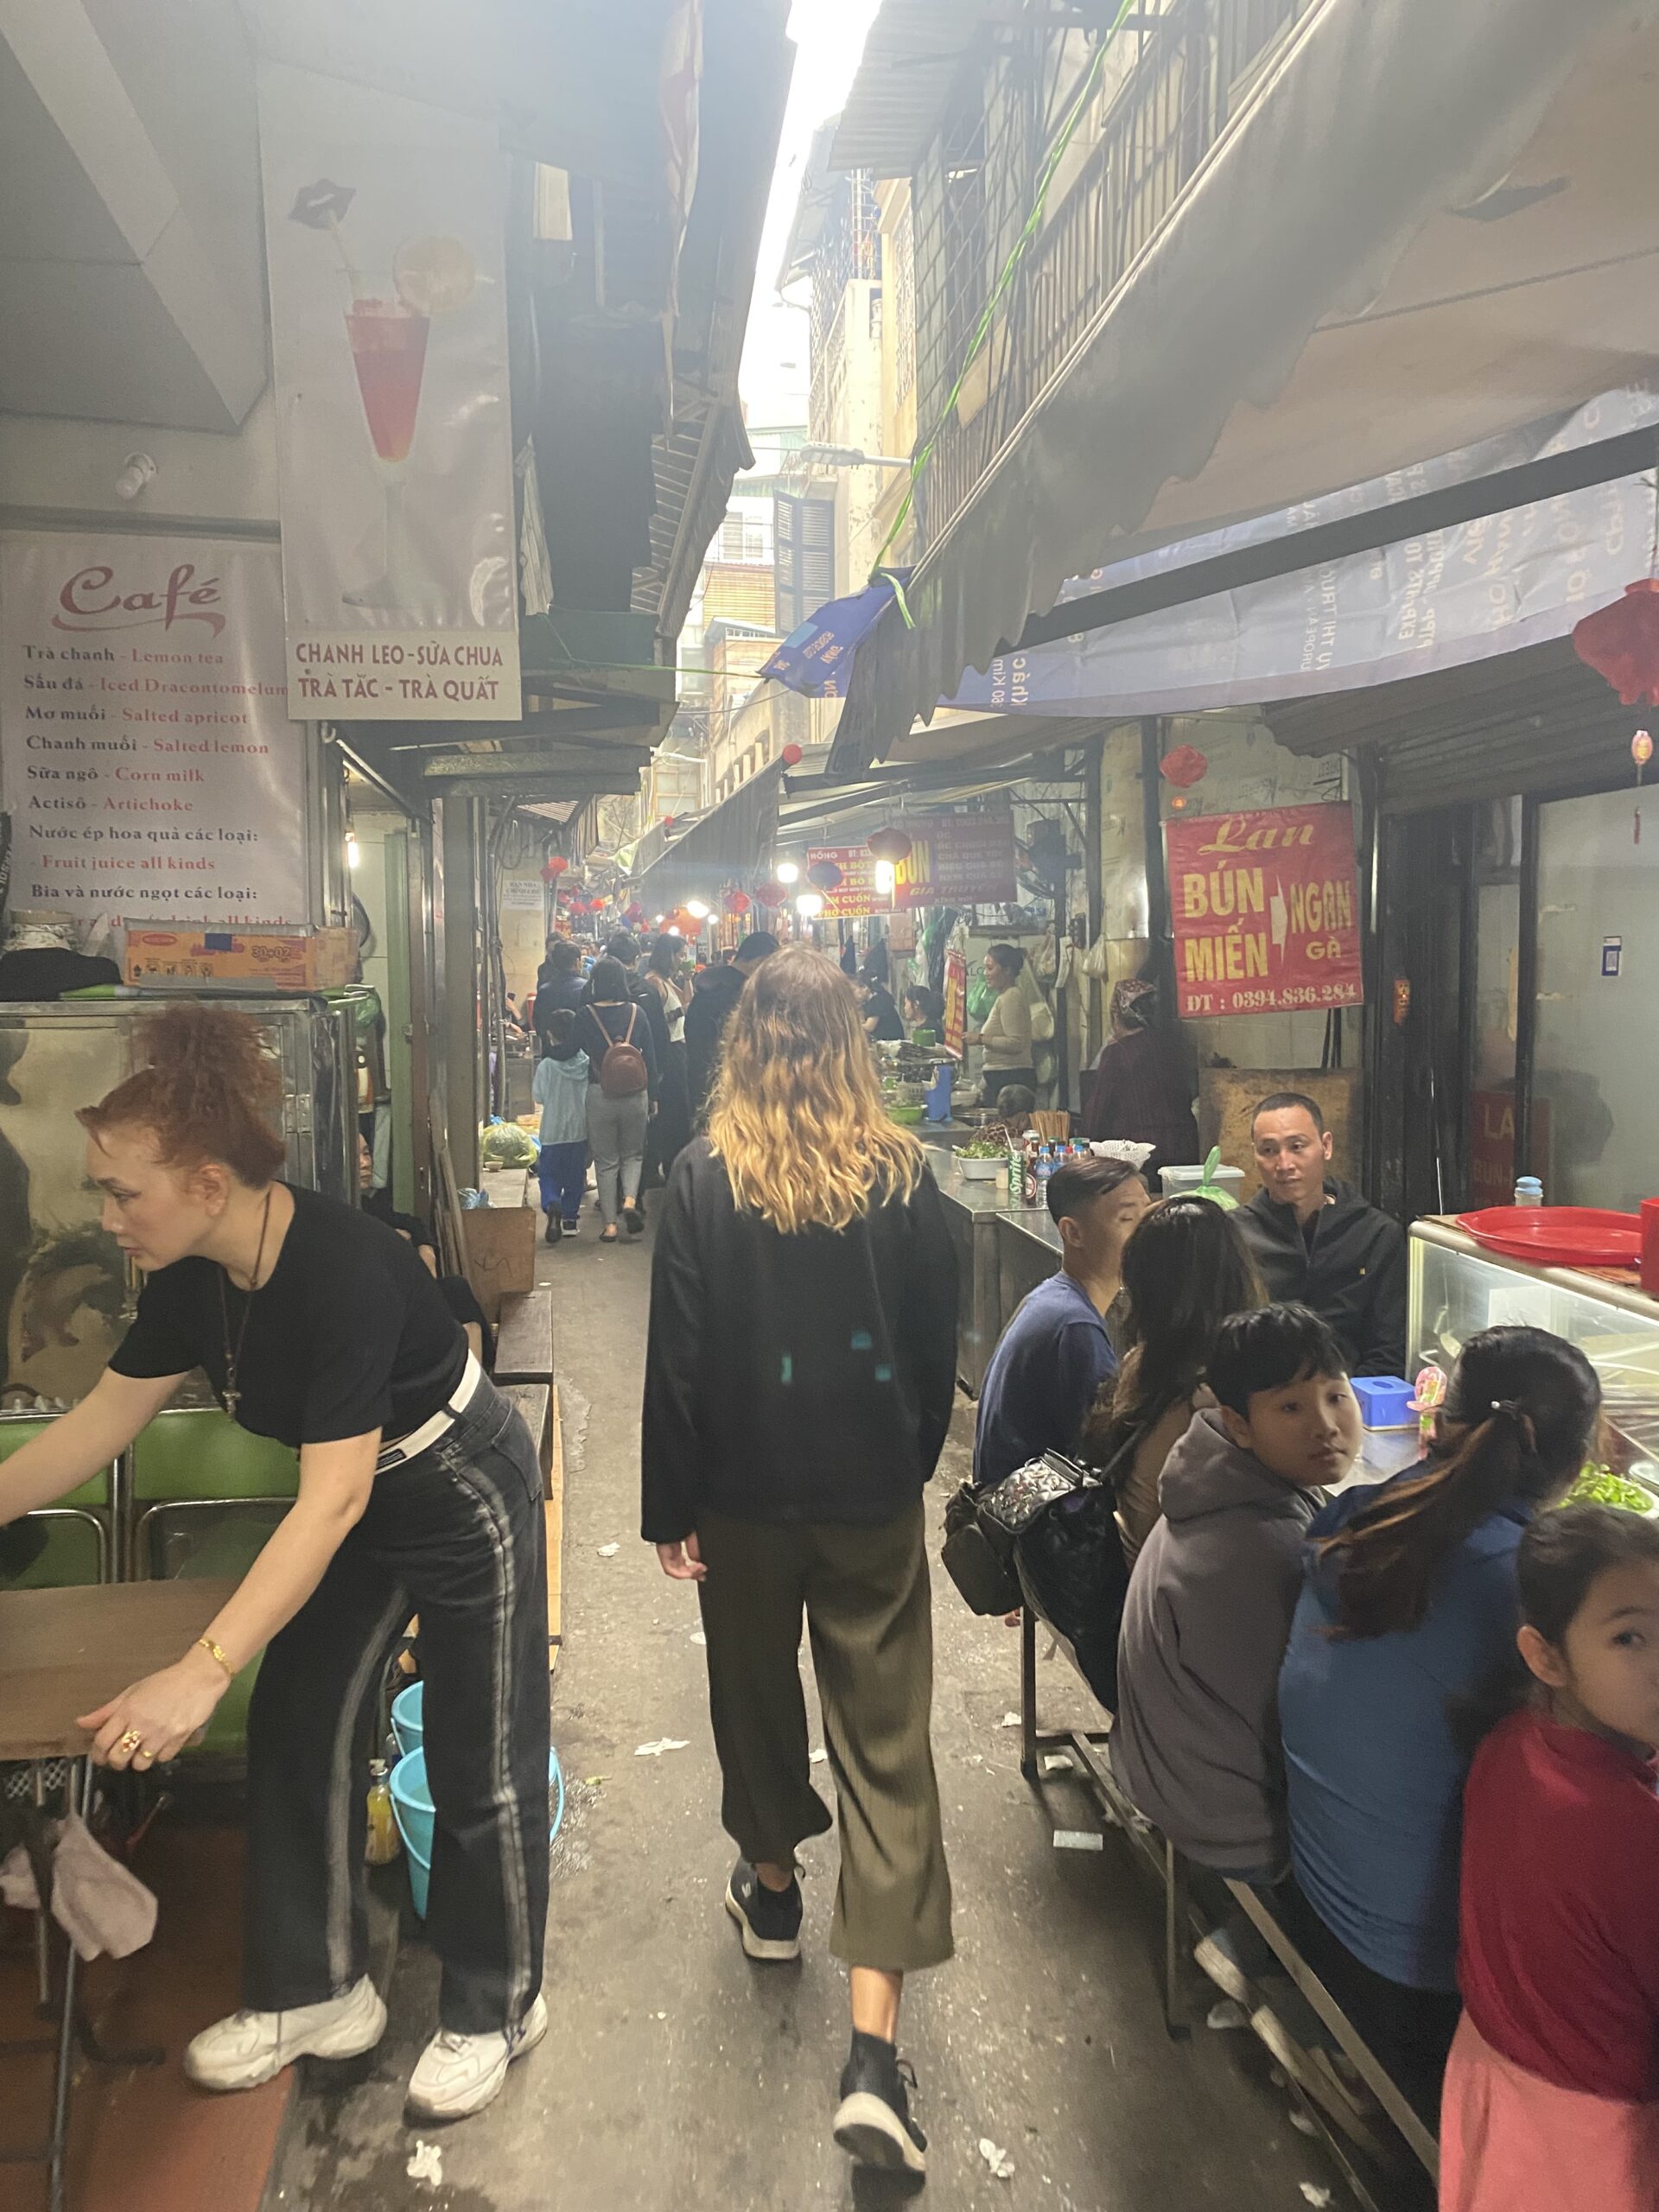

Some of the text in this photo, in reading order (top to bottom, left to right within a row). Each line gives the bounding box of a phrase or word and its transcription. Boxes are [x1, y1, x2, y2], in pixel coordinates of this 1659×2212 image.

[60, 563, 221, 631] Café
[60, 646, 114, 663] chanh
[131, 648, 193, 664] Lemon
[198, 651, 224, 664] tea
[296, 643, 364, 664] CHANH
[372, 645, 404, 665] LEO
[454, 645, 503, 667] CHUA
[100, 677, 140, 692] Iced
[298, 672, 337, 698] TRÀ
[398, 672, 438, 700] TRÀ
[442, 675, 499, 702] QUẤT
[25, 704, 248, 728] Mơ muối Salted apricot
[26, 734, 270, 754] Chanh muối Salted lemon
[66, 767, 99, 783] ngô
[115, 767, 161, 782] Corn
[167, 769, 205, 783] milk
[28, 795, 194, 812] Actisô Artichoke
[29, 824, 78, 840] Nước
[82, 827, 104, 843] ép
[109, 827, 142, 841] hoa
[187, 828, 213, 842] các
[218, 829, 258, 846] loại:
[1197, 815, 1314, 856] Lan
[42, 855, 215, 872] Fruit juice all kinds
[31, 884, 257, 904] Bia và nước ngọt các loại:
[1183, 859, 1352, 934] BÚN NGAN
[1185, 917, 1342, 983] MIẾN GÀ
[1009, 1154, 1023, 1194] Sprite
